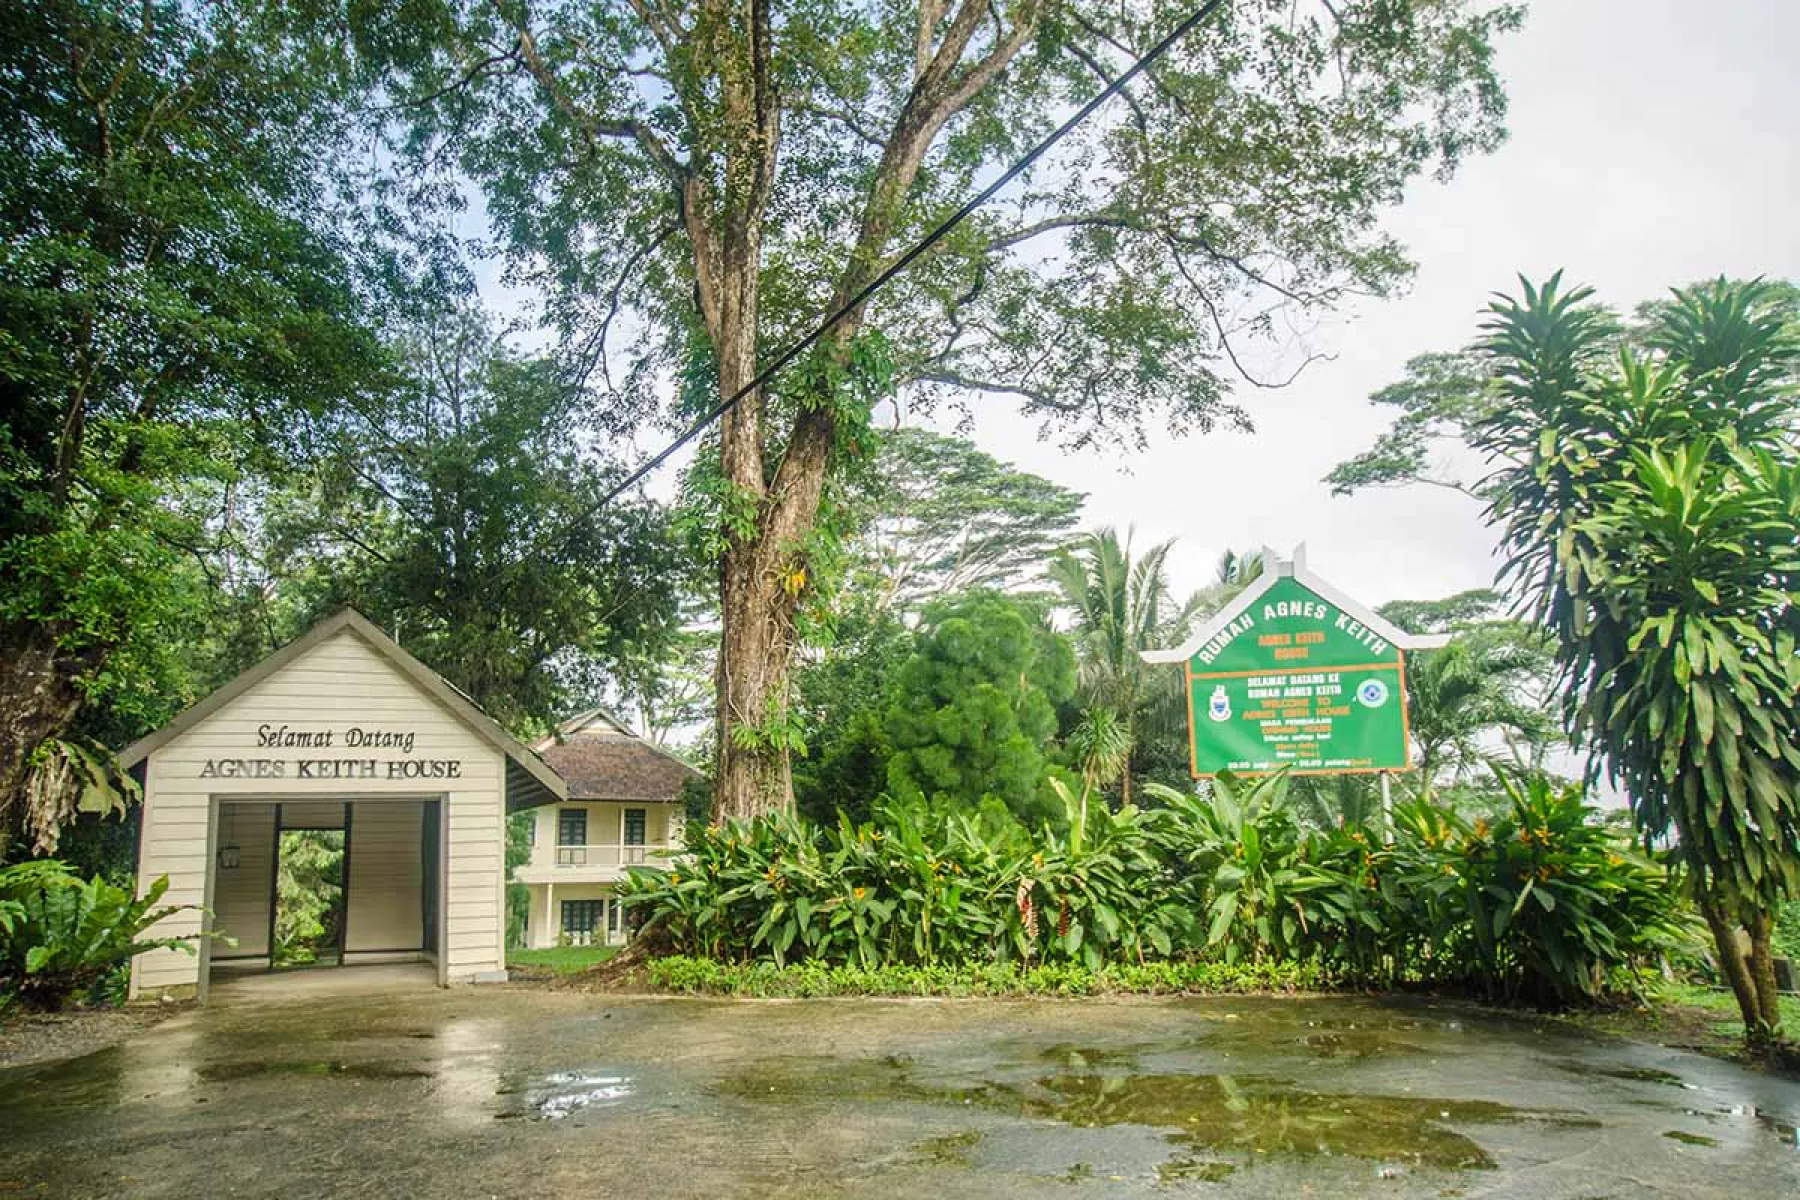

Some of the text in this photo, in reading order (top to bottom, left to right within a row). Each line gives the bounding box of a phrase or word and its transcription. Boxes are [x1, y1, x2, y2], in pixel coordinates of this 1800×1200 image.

[1198, 601, 1388, 665] RUMAH AGNES KEITH
[1247, 672, 1340, 687] SELAMAT DATANG KE
[1247, 684, 1341, 699] RUMAH AGNES KEITH
[257, 723, 416, 753] Selamat Datang
[199, 759, 462, 780] AGNES KEITH HOUSE
